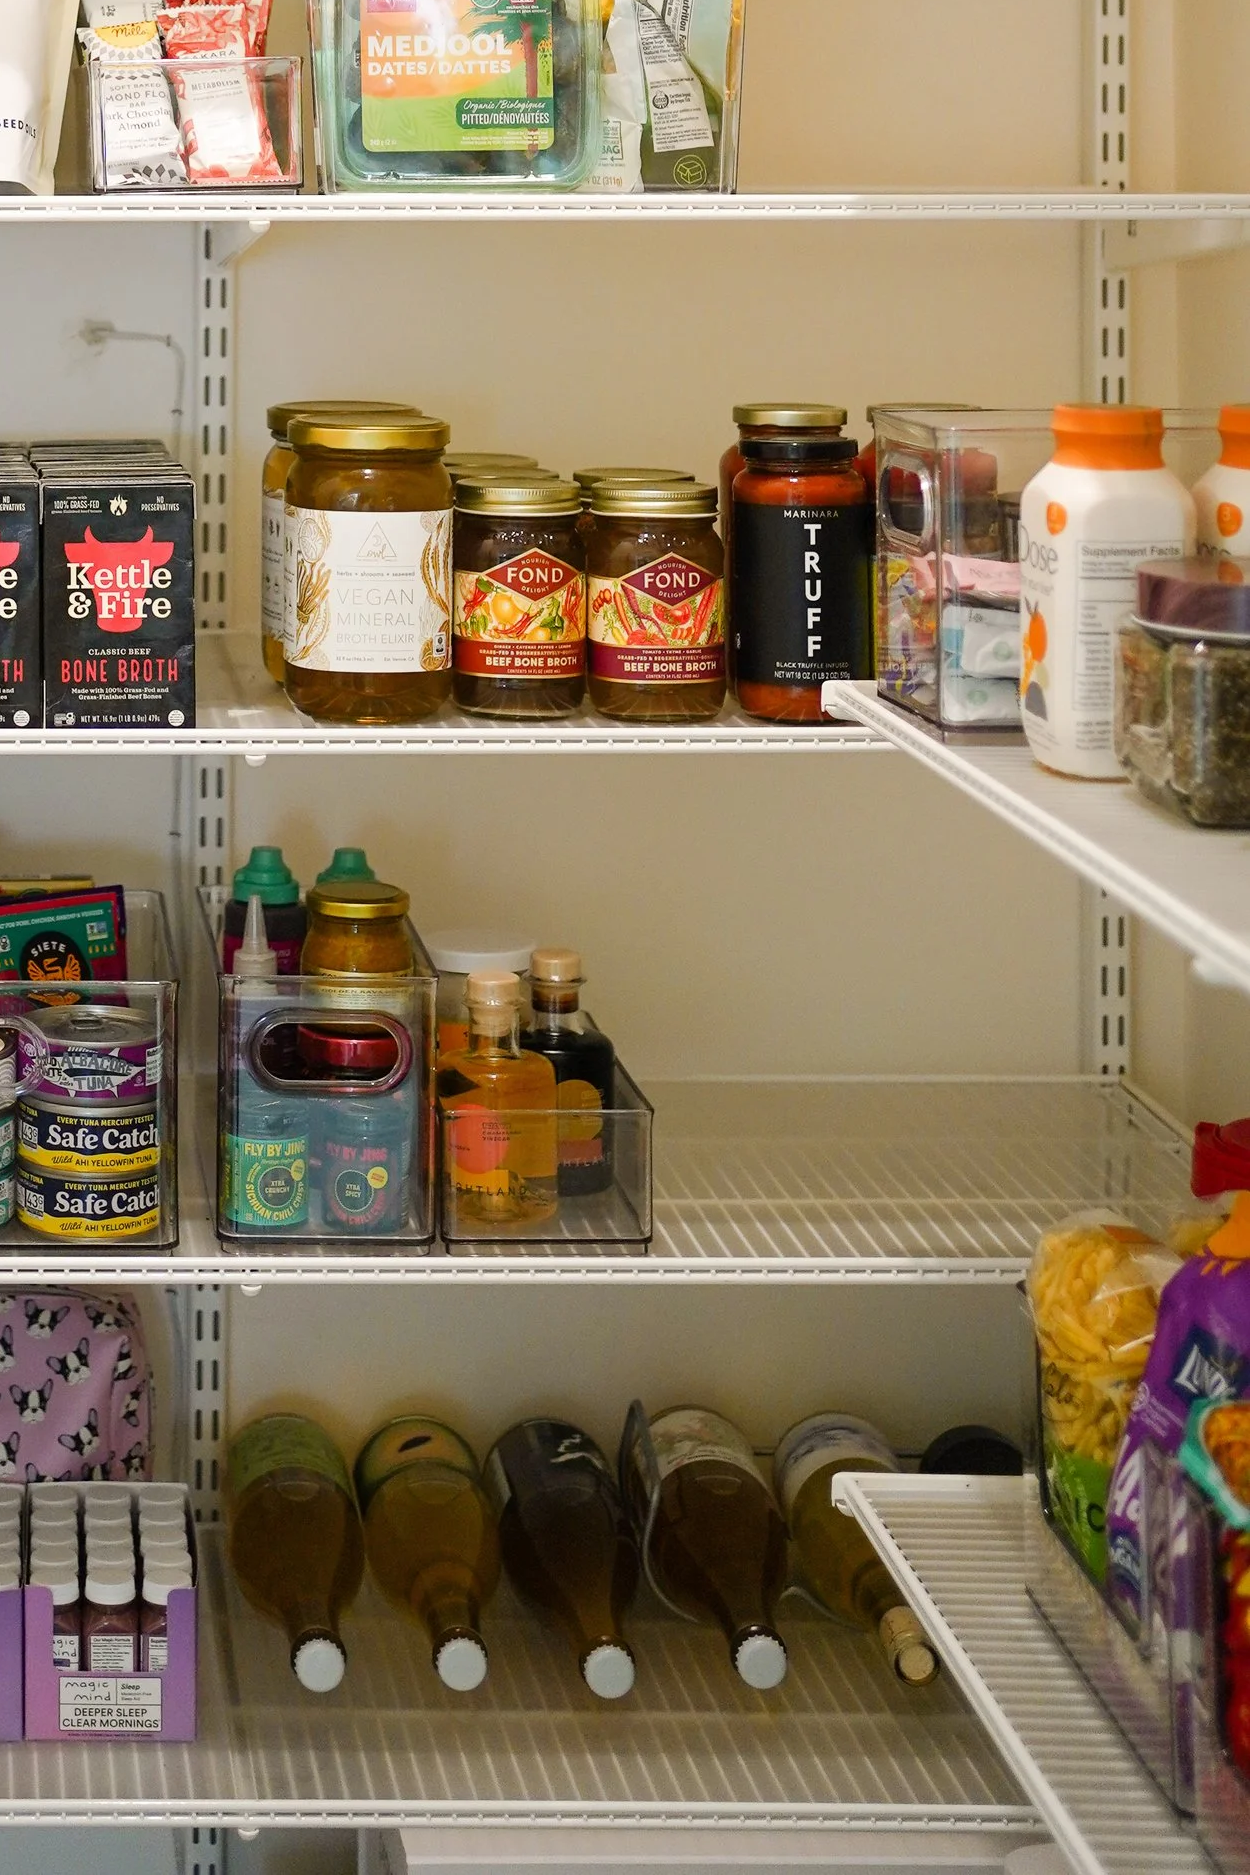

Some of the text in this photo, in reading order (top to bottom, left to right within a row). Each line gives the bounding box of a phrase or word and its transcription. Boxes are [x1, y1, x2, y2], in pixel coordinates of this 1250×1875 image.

[367, 33, 512, 57] MEDJOOL
[191, 80, 240, 90] METABOLISM
[26, 123, 36, 139] OILS
[119, 121, 160, 131] Almond
[784, 510, 838, 518] MARINARA
[1082, 546, 1180, 557] Supplement Facts
[67, 560, 172, 589] Kettle
[507, 568, 563, 583] FOND
[644, 573, 700, 588] FOND
[804, 524, 822, 657] TRUFF
[337, 589, 414, 605] VEGAN
[337, 613, 415, 626] MINERAL
[337, 633, 414, 644] BROTH ELIXIR
[486, 657, 577, 666] BEEF BONE BROTH
[624, 661, 716, 672] BEEF BONE BROTH
[57, 1115, 154, 1126] EVERY TUNA MERCURY TESTED
[46, 1124, 159, 1149] Safe Catch
[244, 1140, 305, 1156] FLY BY JING
[52, 1156, 73, 1164] Wild
[92, 1157, 134, 1167] YELLOWFIN
[136, 1156, 152, 1165] TUNA
[60, 1220, 142, 1232] Wild AHI YELLOWFIN
[74, 1708, 147, 1717] DEEPER SLEEP
[62, 1719, 158, 1728] CLEAR MORNINGS
